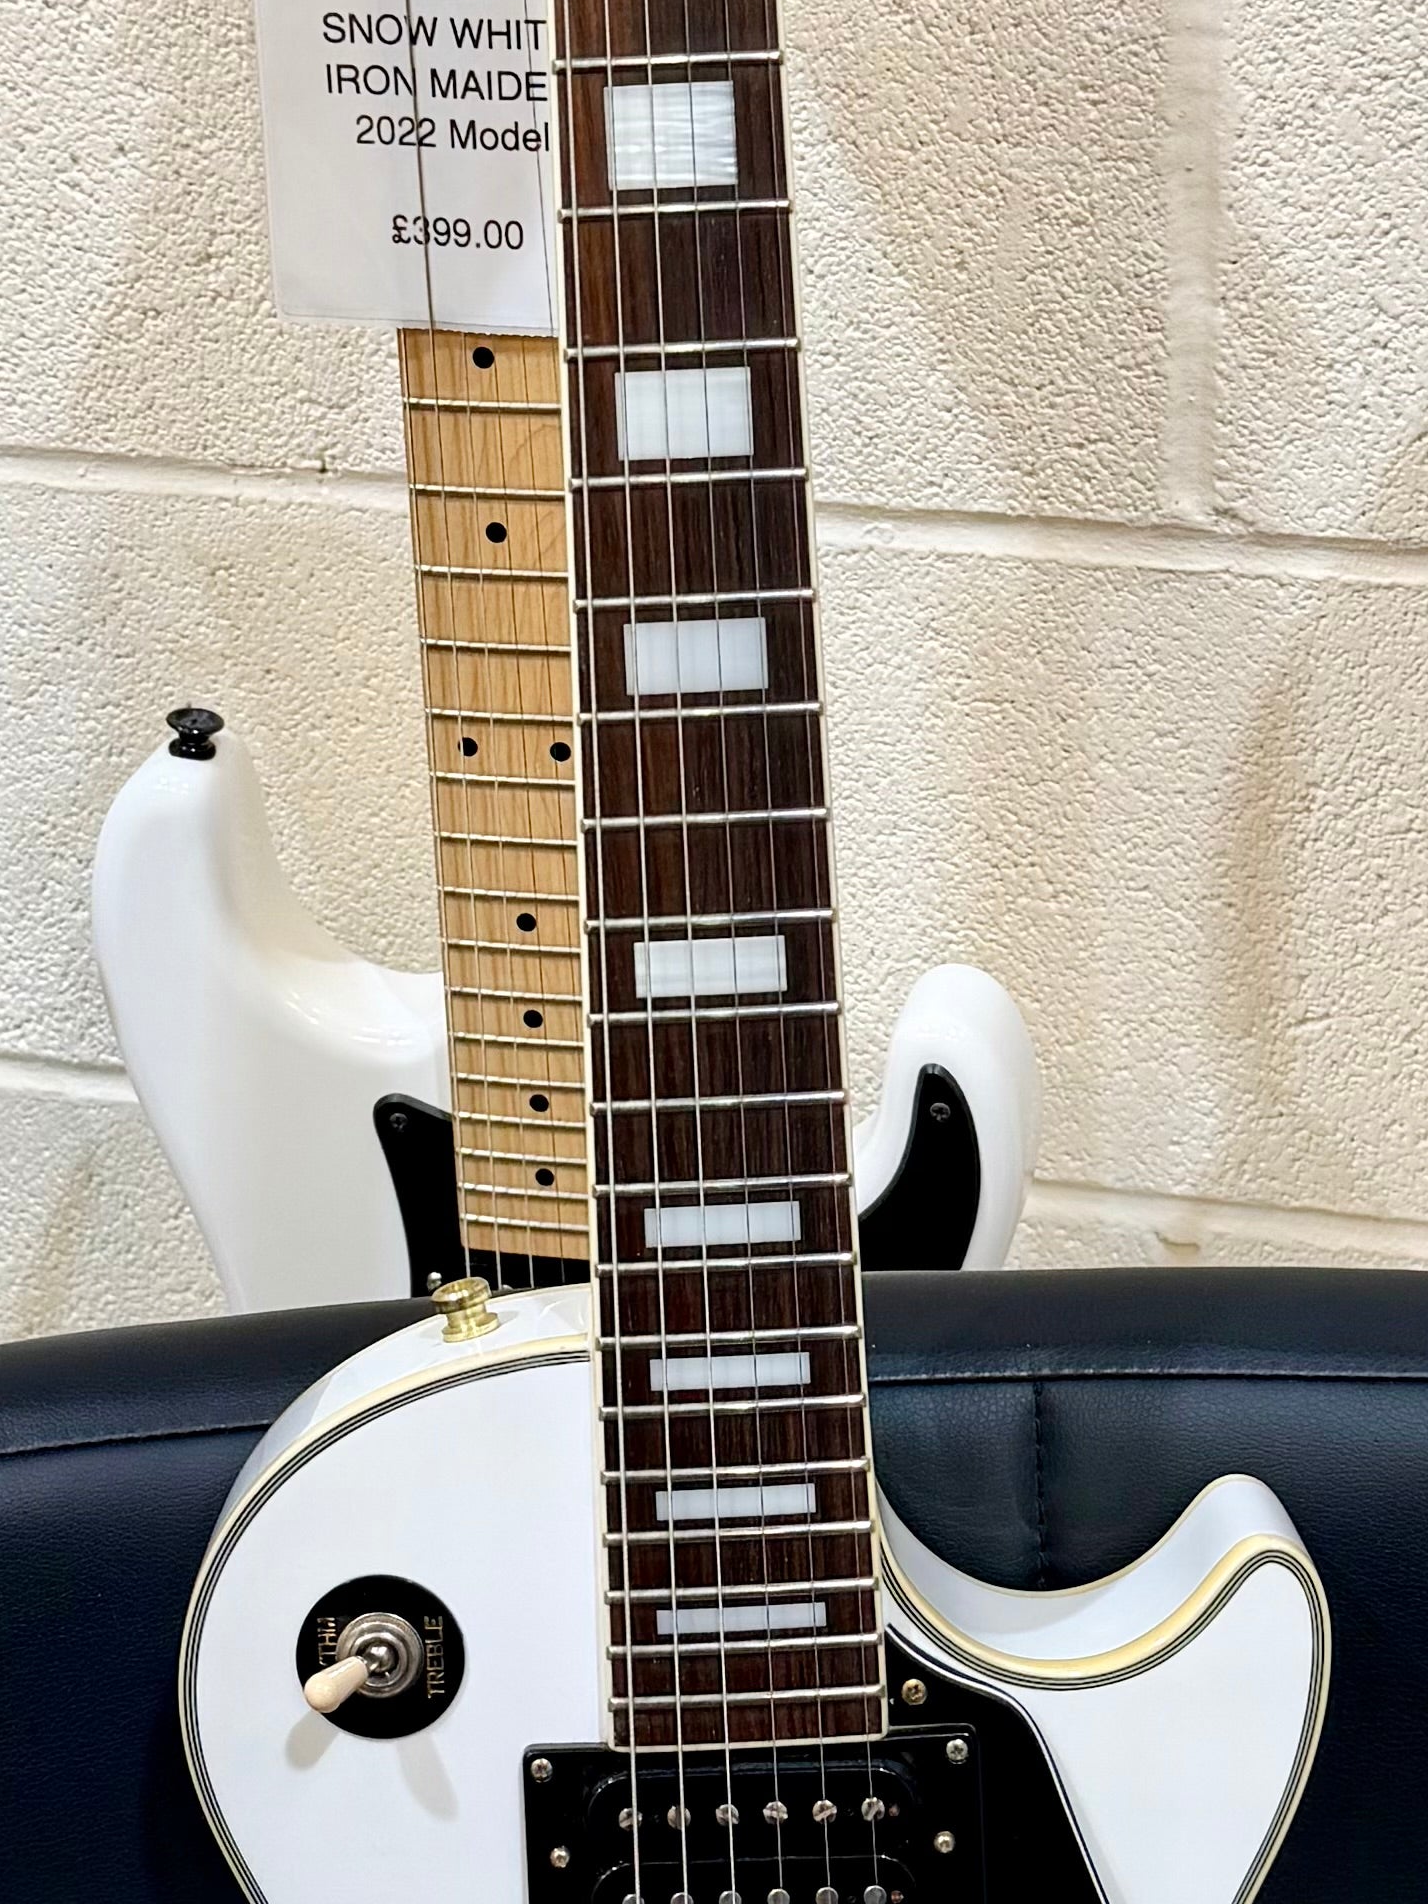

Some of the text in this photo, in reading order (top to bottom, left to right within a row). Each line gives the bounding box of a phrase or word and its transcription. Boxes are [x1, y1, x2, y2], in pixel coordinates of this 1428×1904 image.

[323, 14, 546, 50] SNOW WHIT
[326, 63, 547, 101] IRON MAIDE
[356, 115, 549, 152] 2022 Model
[392, 215, 524, 250] £399.00
[423, 1615, 444, 1698] TREBLE
